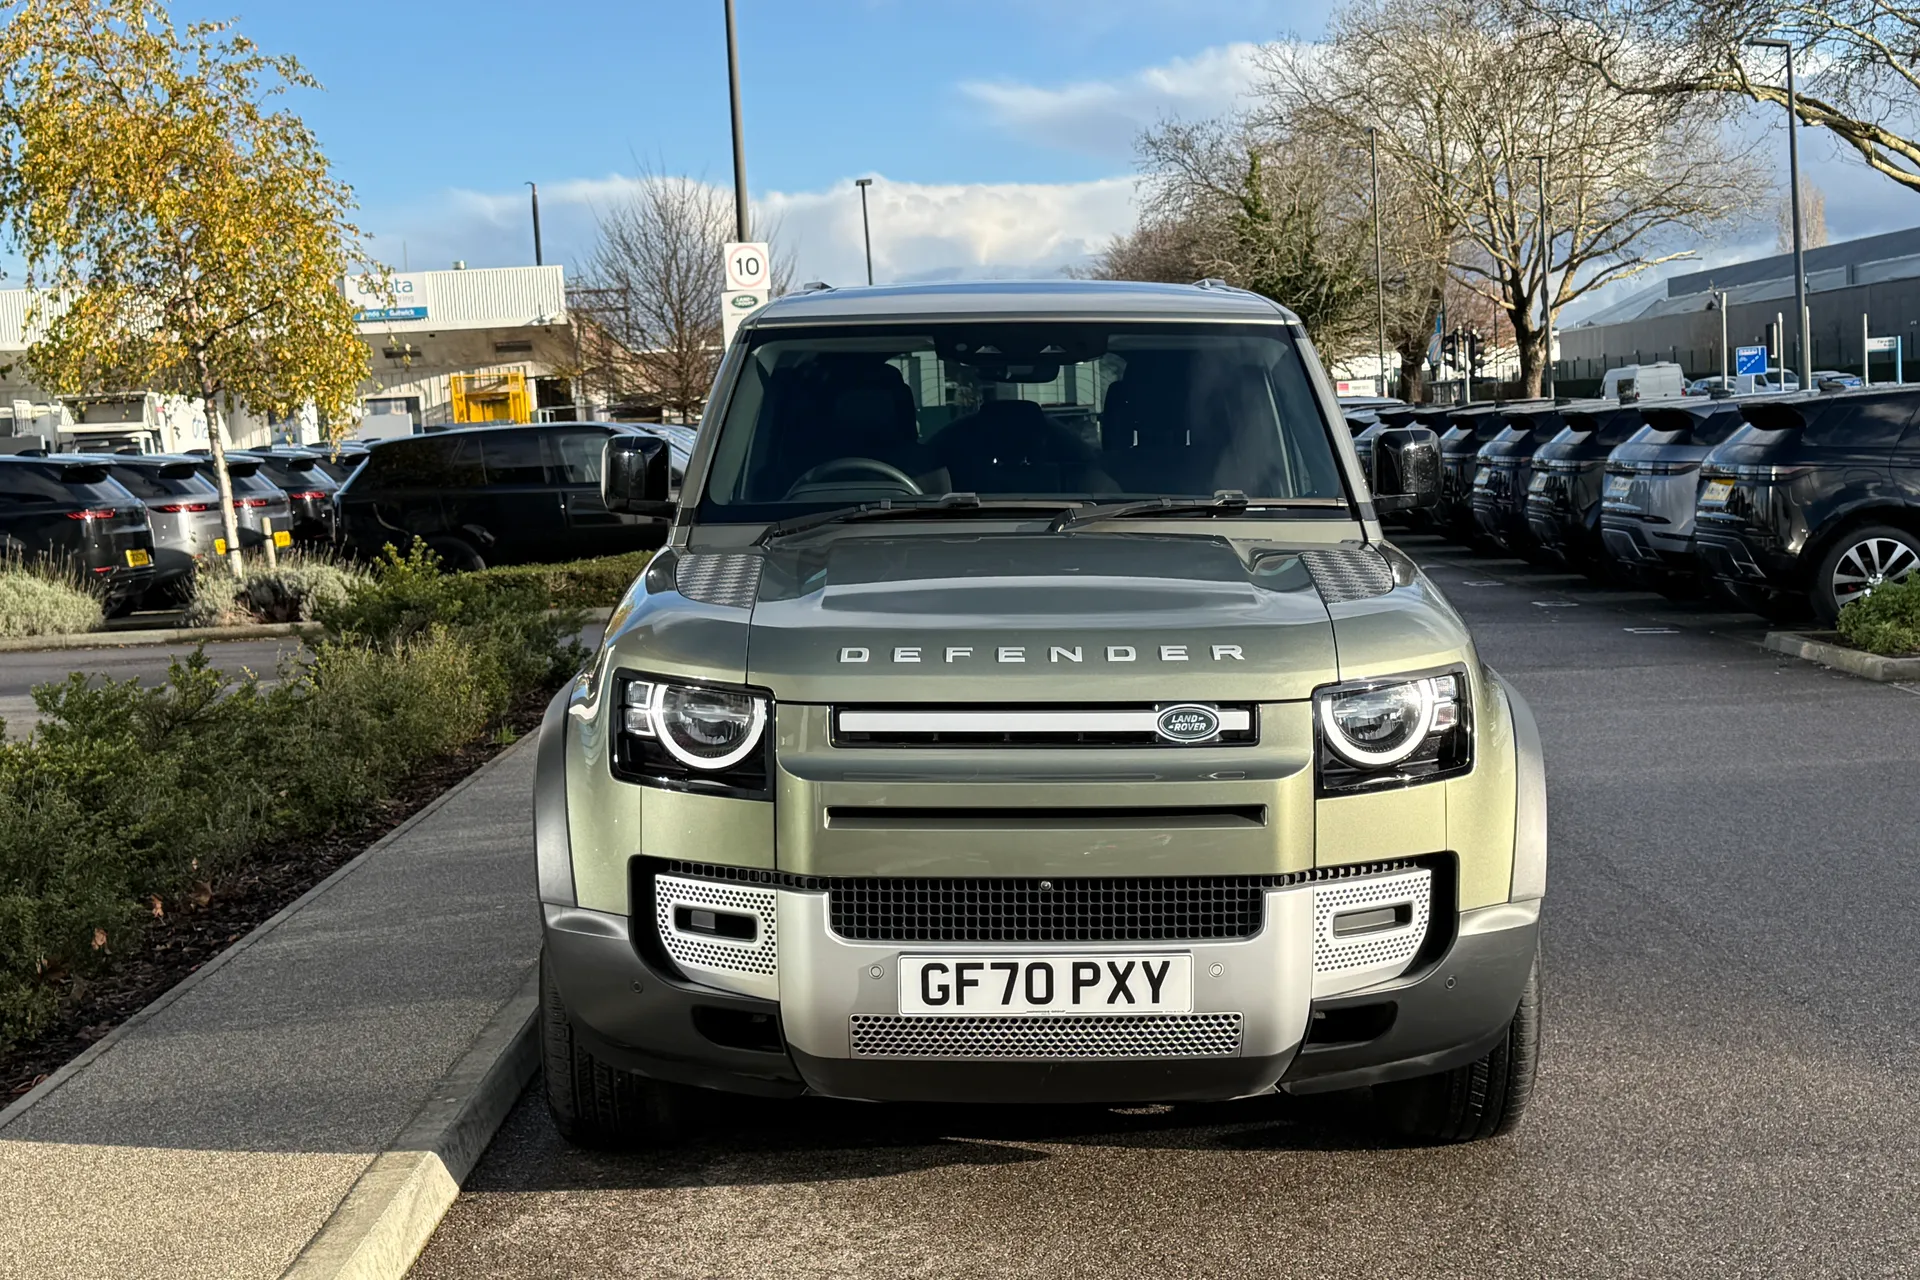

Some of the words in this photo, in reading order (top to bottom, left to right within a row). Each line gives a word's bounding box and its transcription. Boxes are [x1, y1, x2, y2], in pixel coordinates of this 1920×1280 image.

[736, 257, 760, 276] 10
[358, 277, 414, 294] data
[839, 644, 1246, 663] DEFENDER
[1171, 714, 1198, 723] LAND
[1173, 722, 1206, 731] ROVER
[920, 961, 1054, 1006] GF70
[1071, 960, 1171, 1005] PXY
